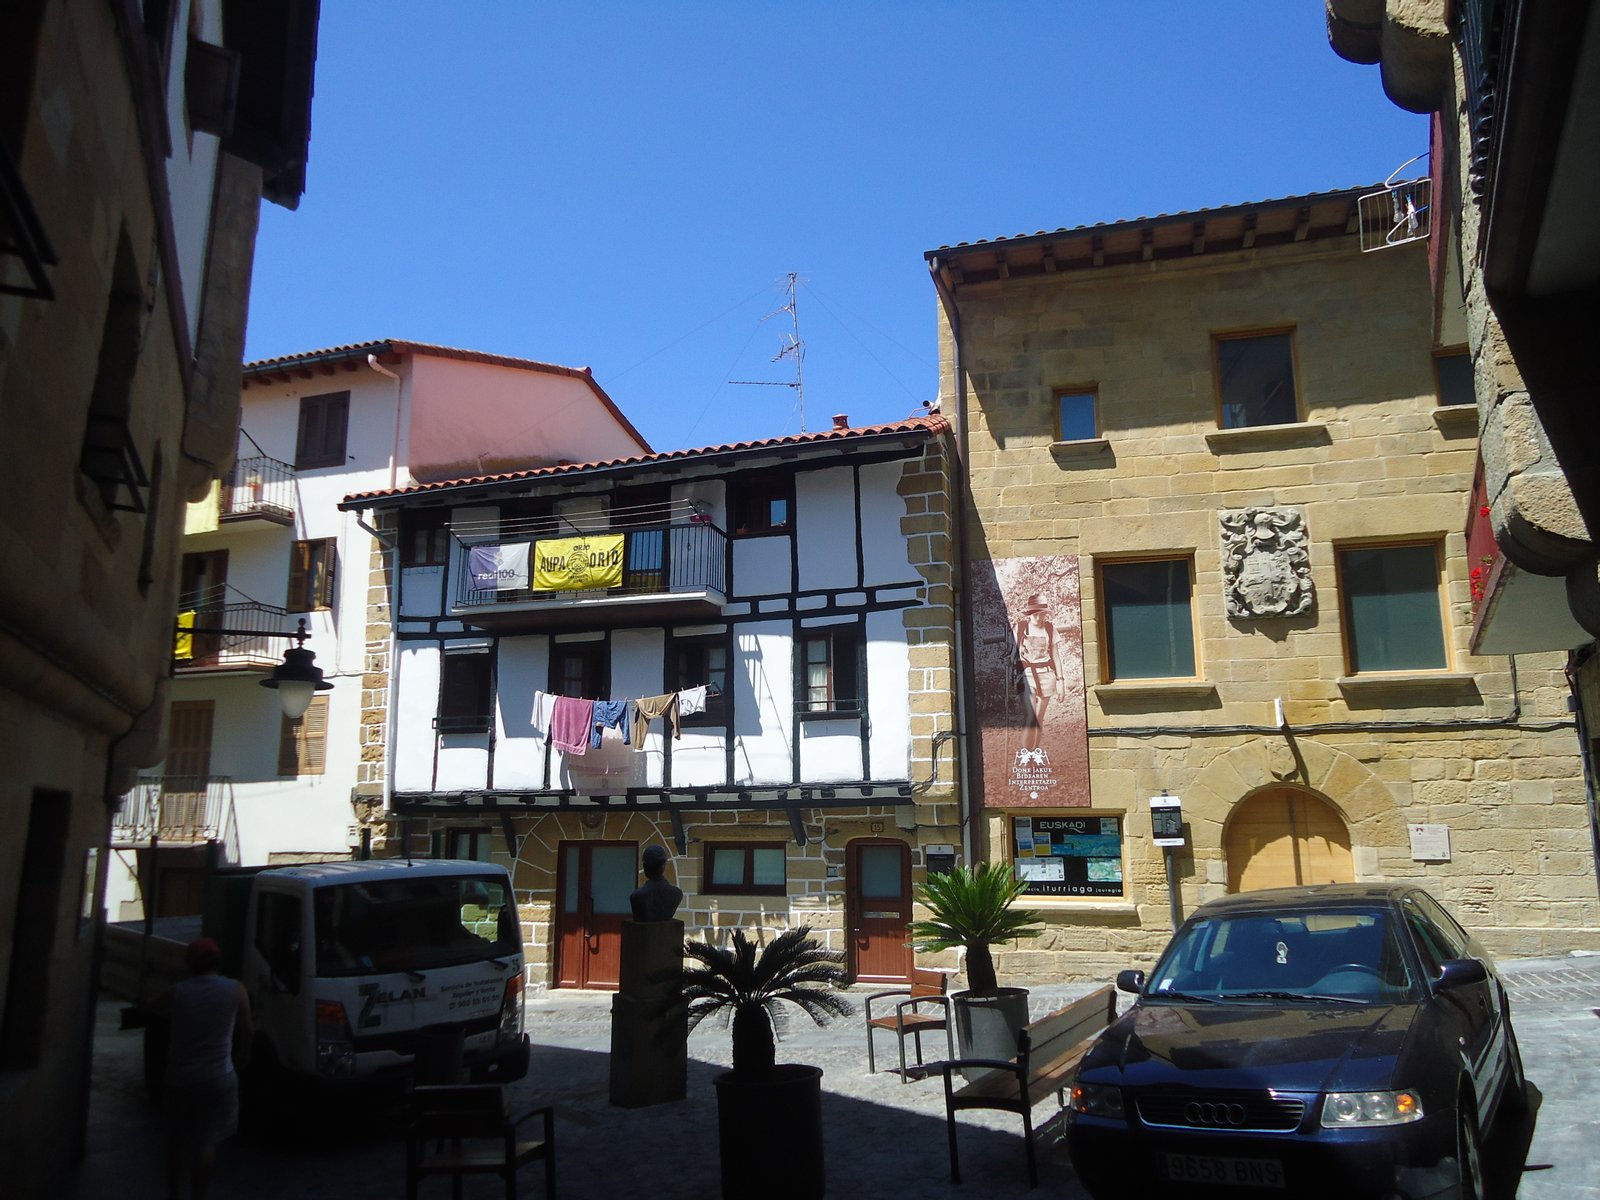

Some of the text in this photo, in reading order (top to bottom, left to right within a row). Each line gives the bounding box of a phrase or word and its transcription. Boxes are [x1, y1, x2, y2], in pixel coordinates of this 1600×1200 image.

[540, 549, 619, 573] AUPA ORIO
[1040, 821, 1086, 830] EUSKADI
[1042, 884, 1093, 894] iturriaga
[1171, 1155, 1281, 1184] 9658 BNS
